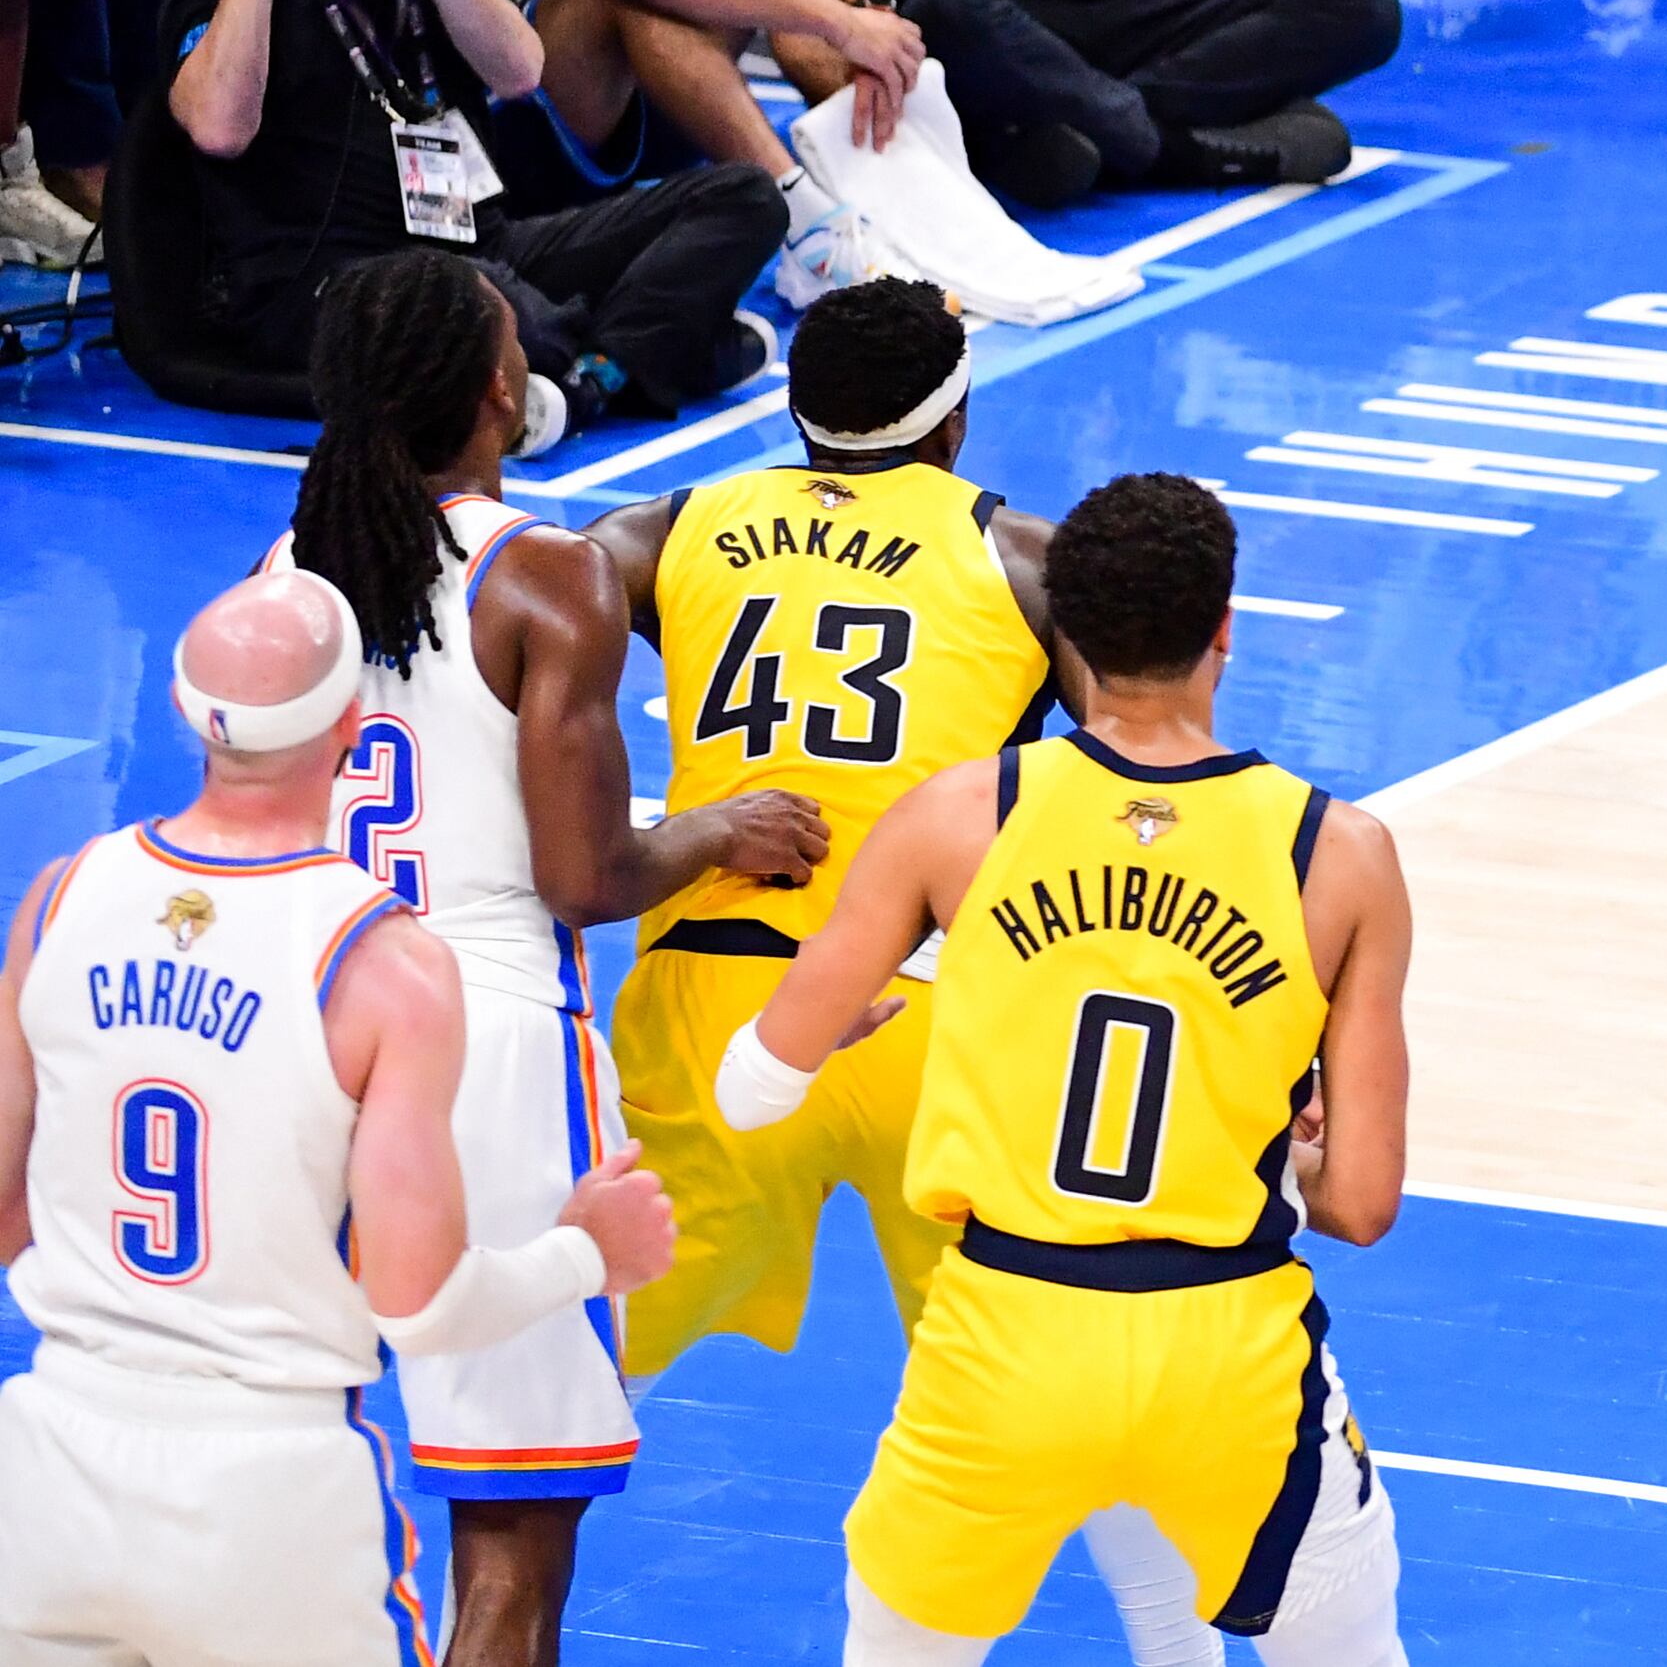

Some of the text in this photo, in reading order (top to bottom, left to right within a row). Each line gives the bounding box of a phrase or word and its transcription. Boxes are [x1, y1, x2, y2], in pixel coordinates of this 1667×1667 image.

[715, 517, 921, 579] SIAKAM
[693, 596, 912, 766] 43
[88, 958, 262, 1053] CARUSO
[990, 865, 1287, 1009] HALIBURTON
[1050, 990, 1176, 1203] 0
[112, 1077, 209, 1286] 9
